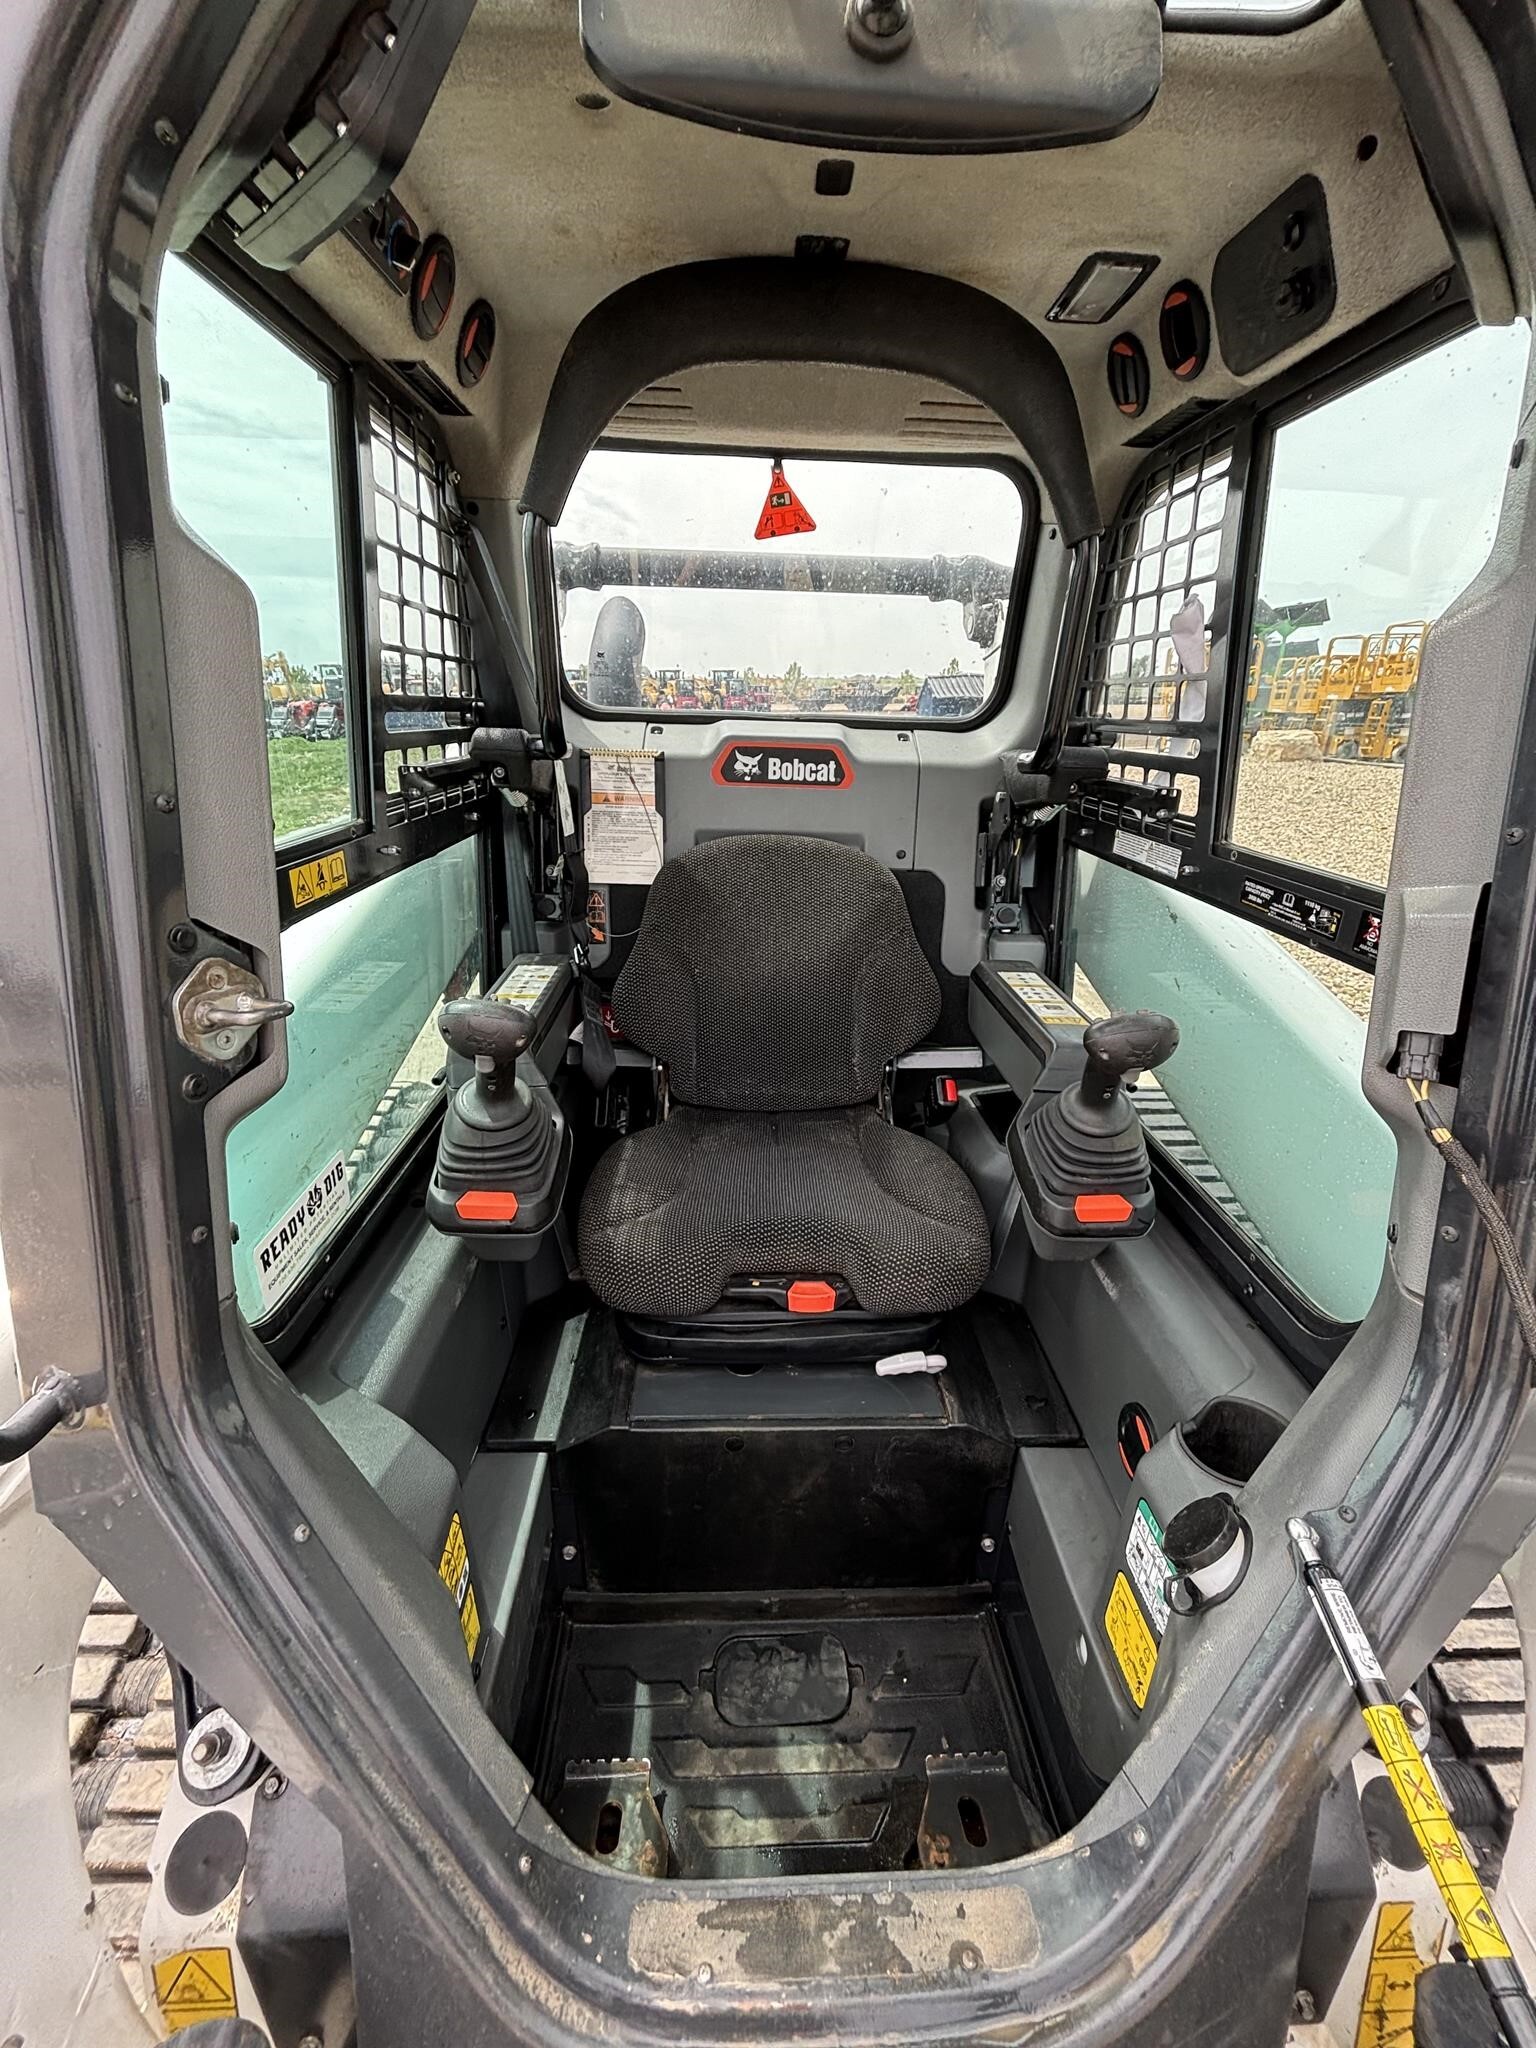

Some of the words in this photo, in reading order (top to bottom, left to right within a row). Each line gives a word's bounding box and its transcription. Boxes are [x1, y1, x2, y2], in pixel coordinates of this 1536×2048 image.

[767, 757, 837, 782] Bobcat
[259, 1205, 306, 1274] READY
[323, 1161, 344, 1196] DIG
